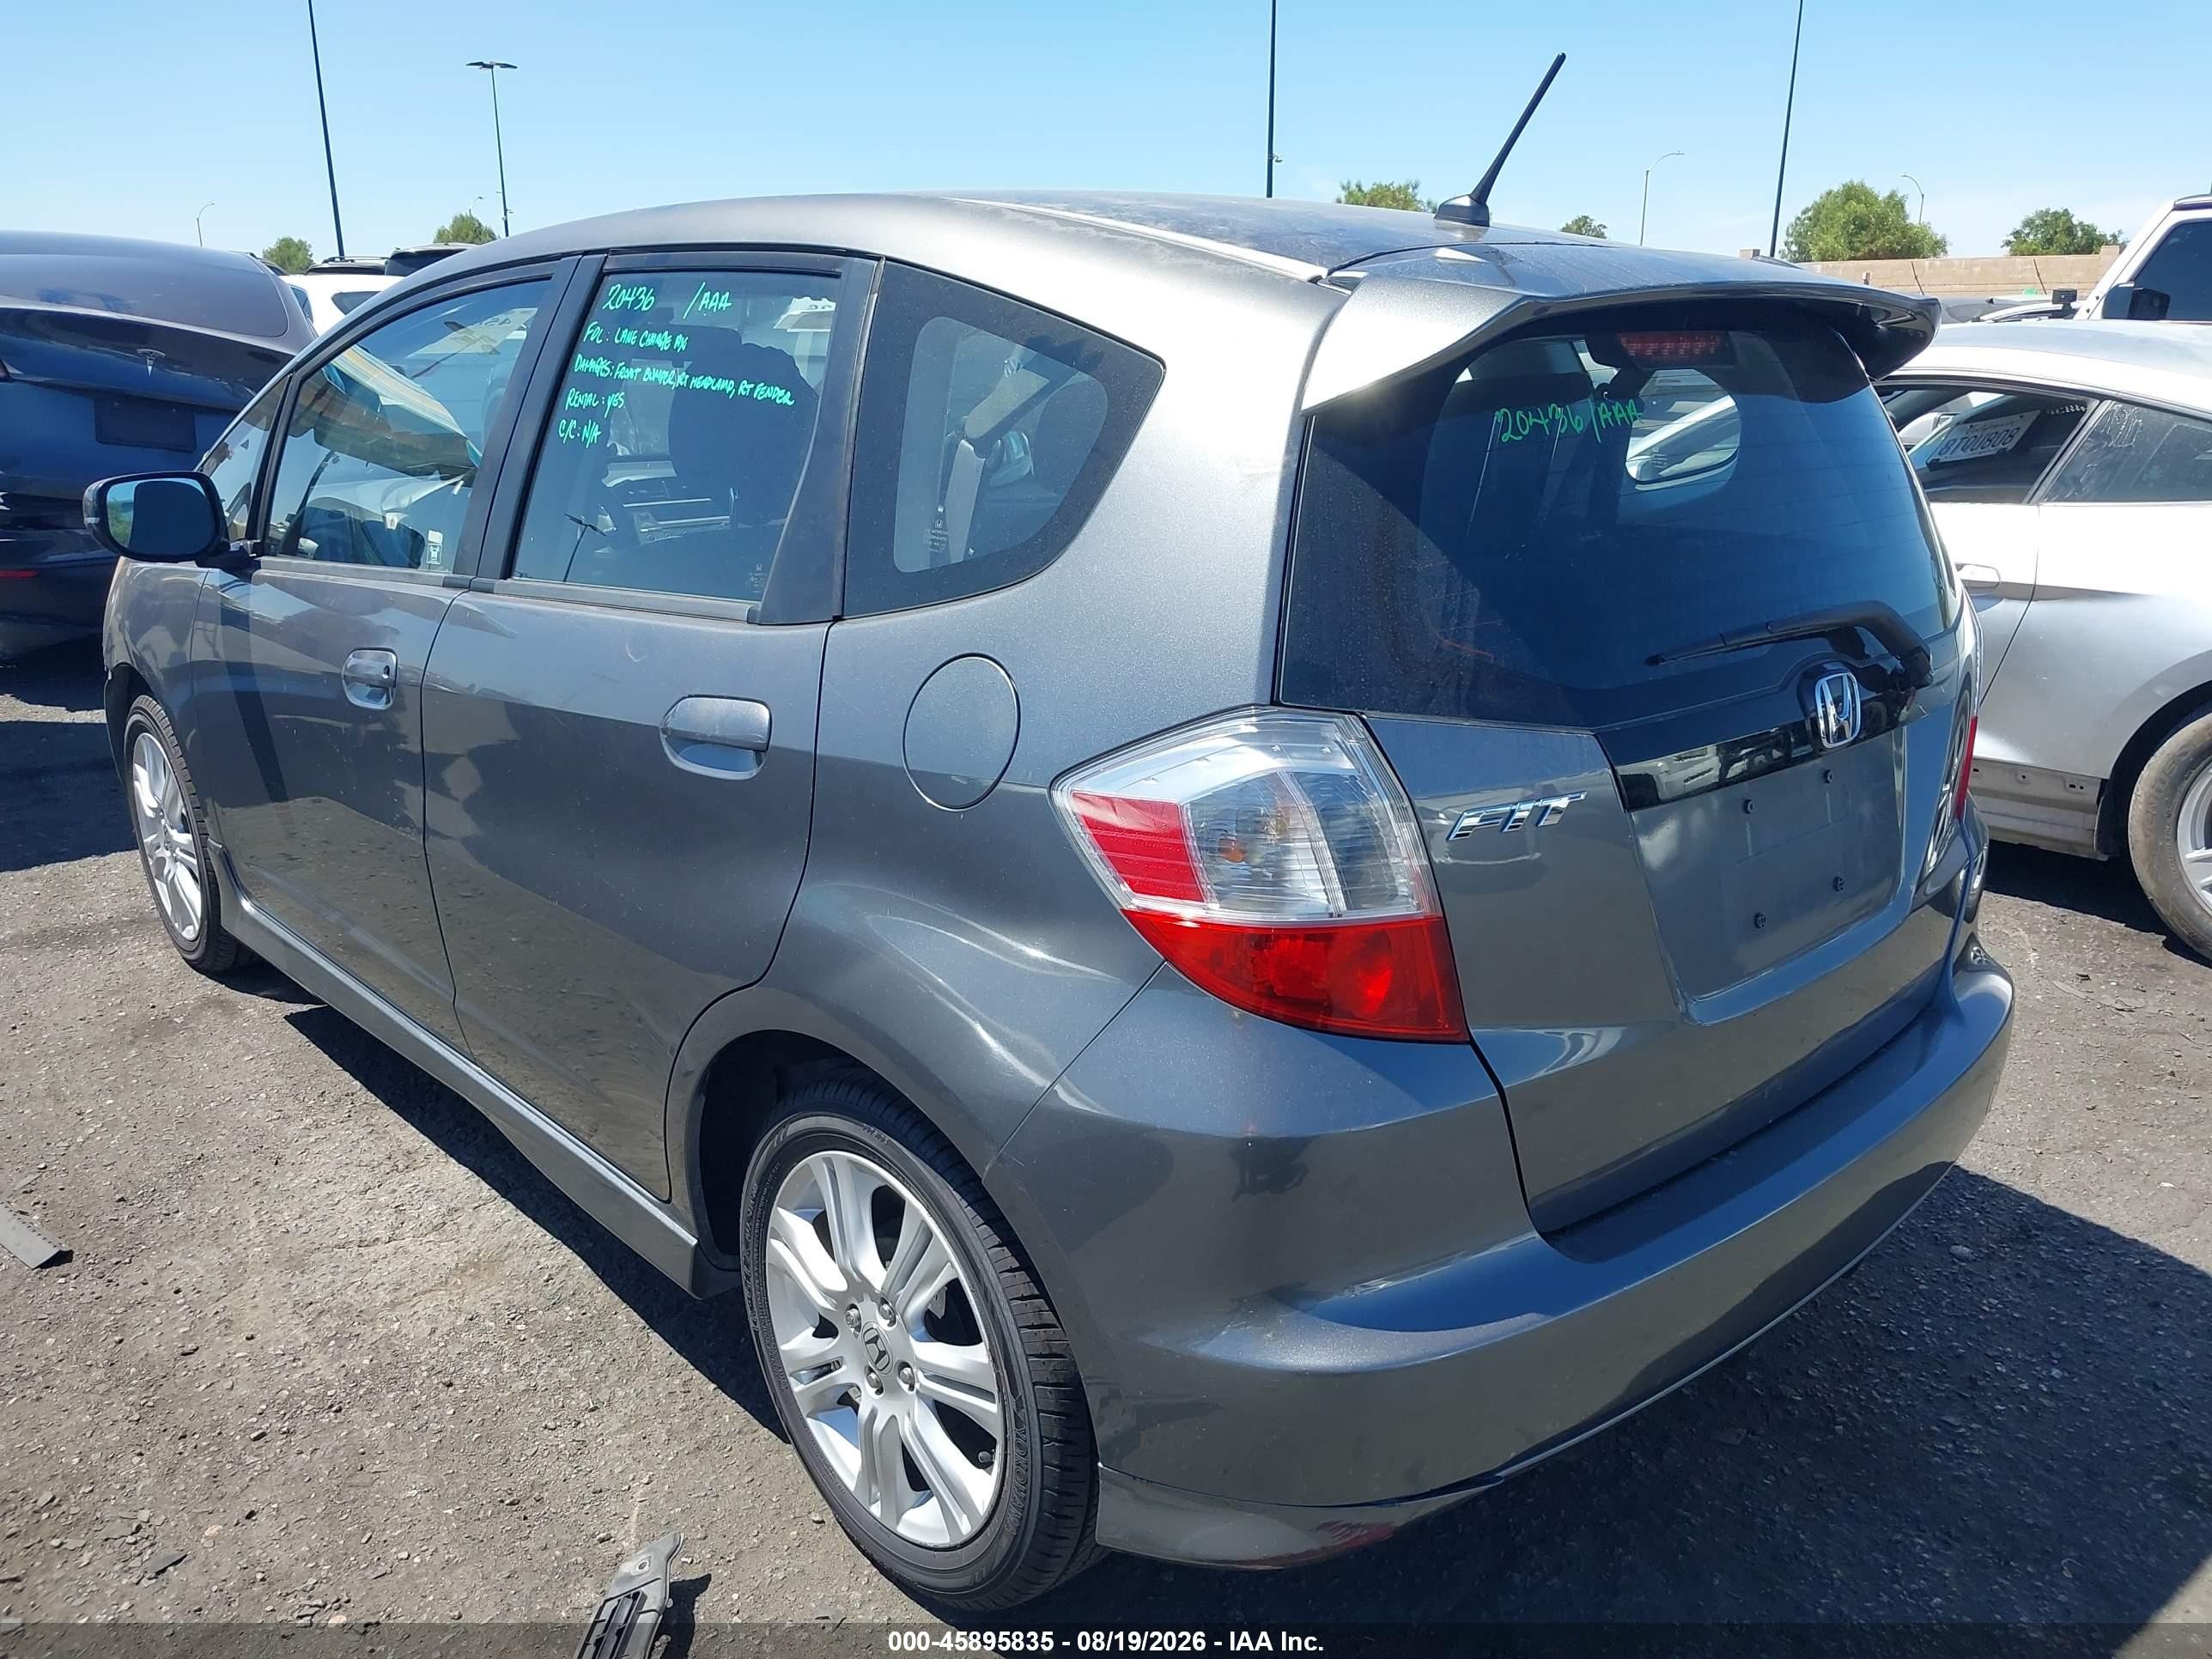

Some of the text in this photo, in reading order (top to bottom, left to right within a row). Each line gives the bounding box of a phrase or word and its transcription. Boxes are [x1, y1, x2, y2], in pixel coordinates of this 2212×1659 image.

[602, 282, 732, 319] 20436 /AAA
[614, 327, 638, 343] LANE
[639, 331, 673, 350] CHANGE
[574, 353, 615, 378] DAMAGES:
[613, 362, 642, 380] FRONT
[738, 380, 755, 397] RT
[753, 382, 795, 406] FENDER
[581, 418, 602, 448] N/A
[1446, 790, 1588, 842] FIT
[1003, 1426, 1029, 1536] YOKOHAMA
